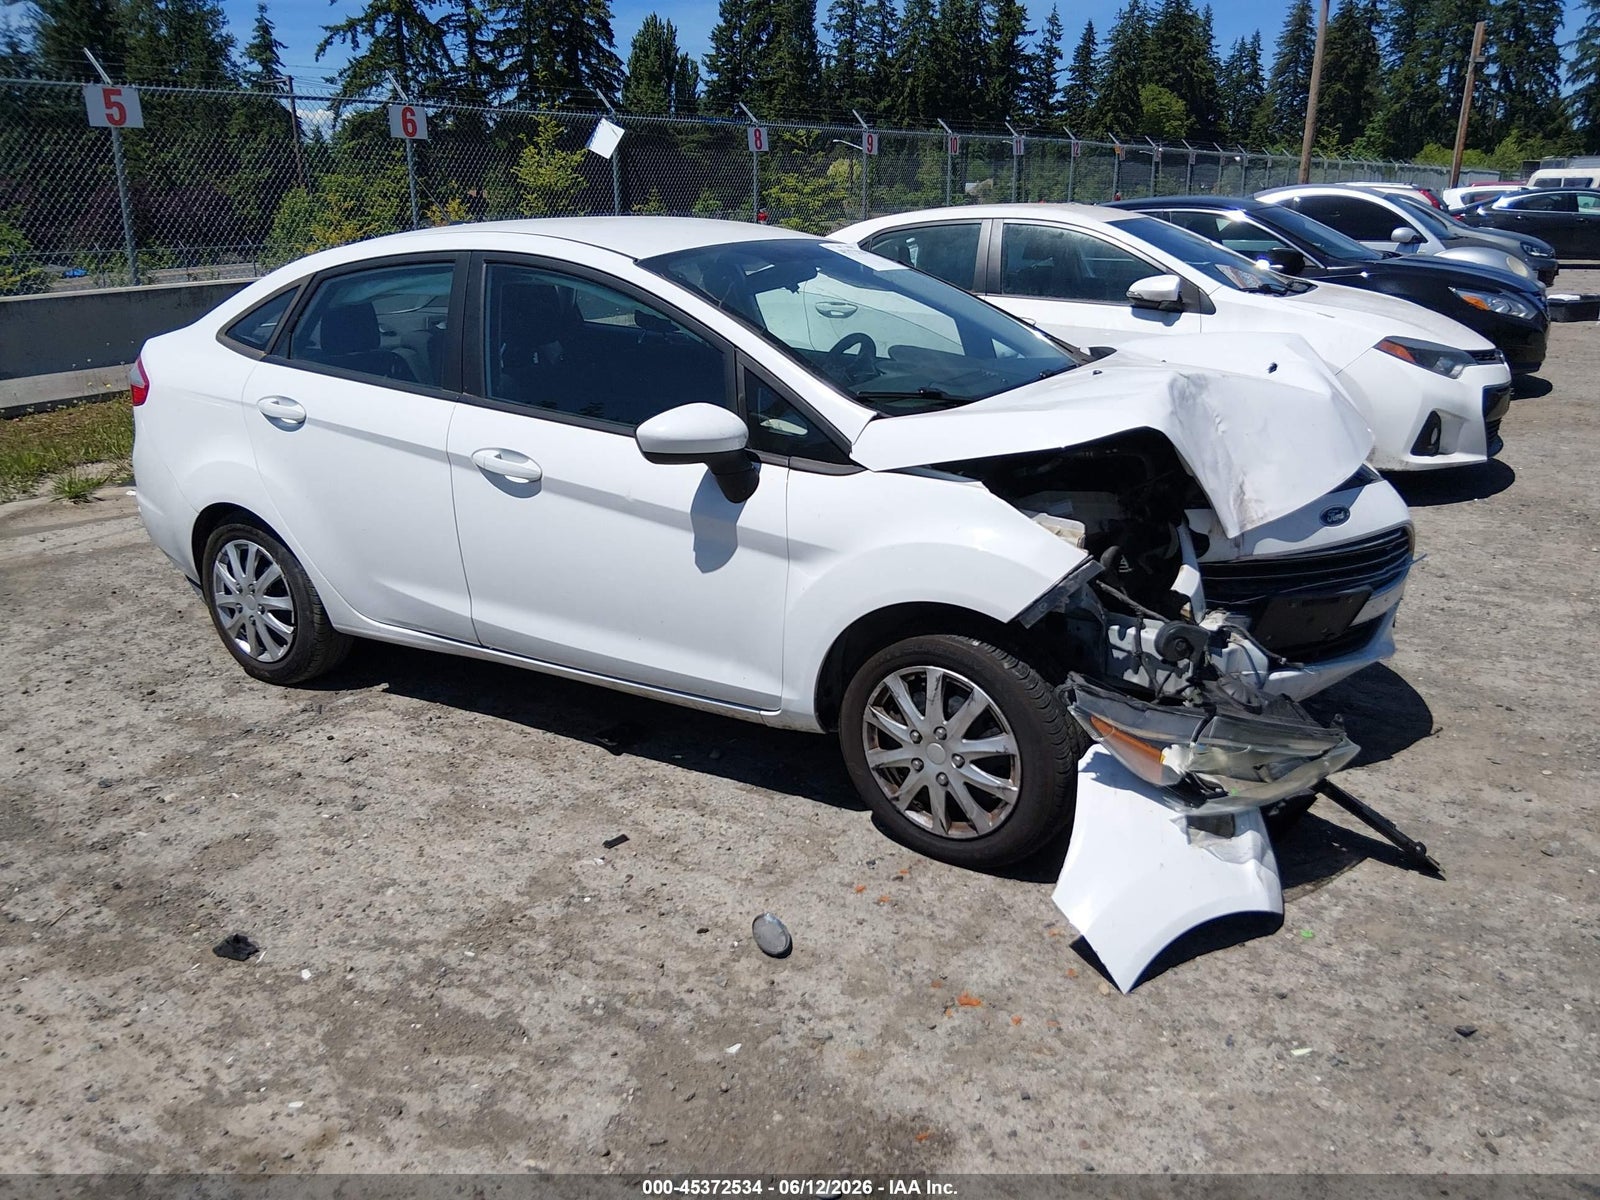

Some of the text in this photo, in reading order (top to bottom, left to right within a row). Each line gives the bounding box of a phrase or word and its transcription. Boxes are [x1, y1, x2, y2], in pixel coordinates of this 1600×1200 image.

[102, 87, 127, 126] 5
[401, 106, 417, 137] 6
[754, 128, 762, 150] 8
[867, 134, 873, 153] 9
[950, 137, 958, 154] 10
